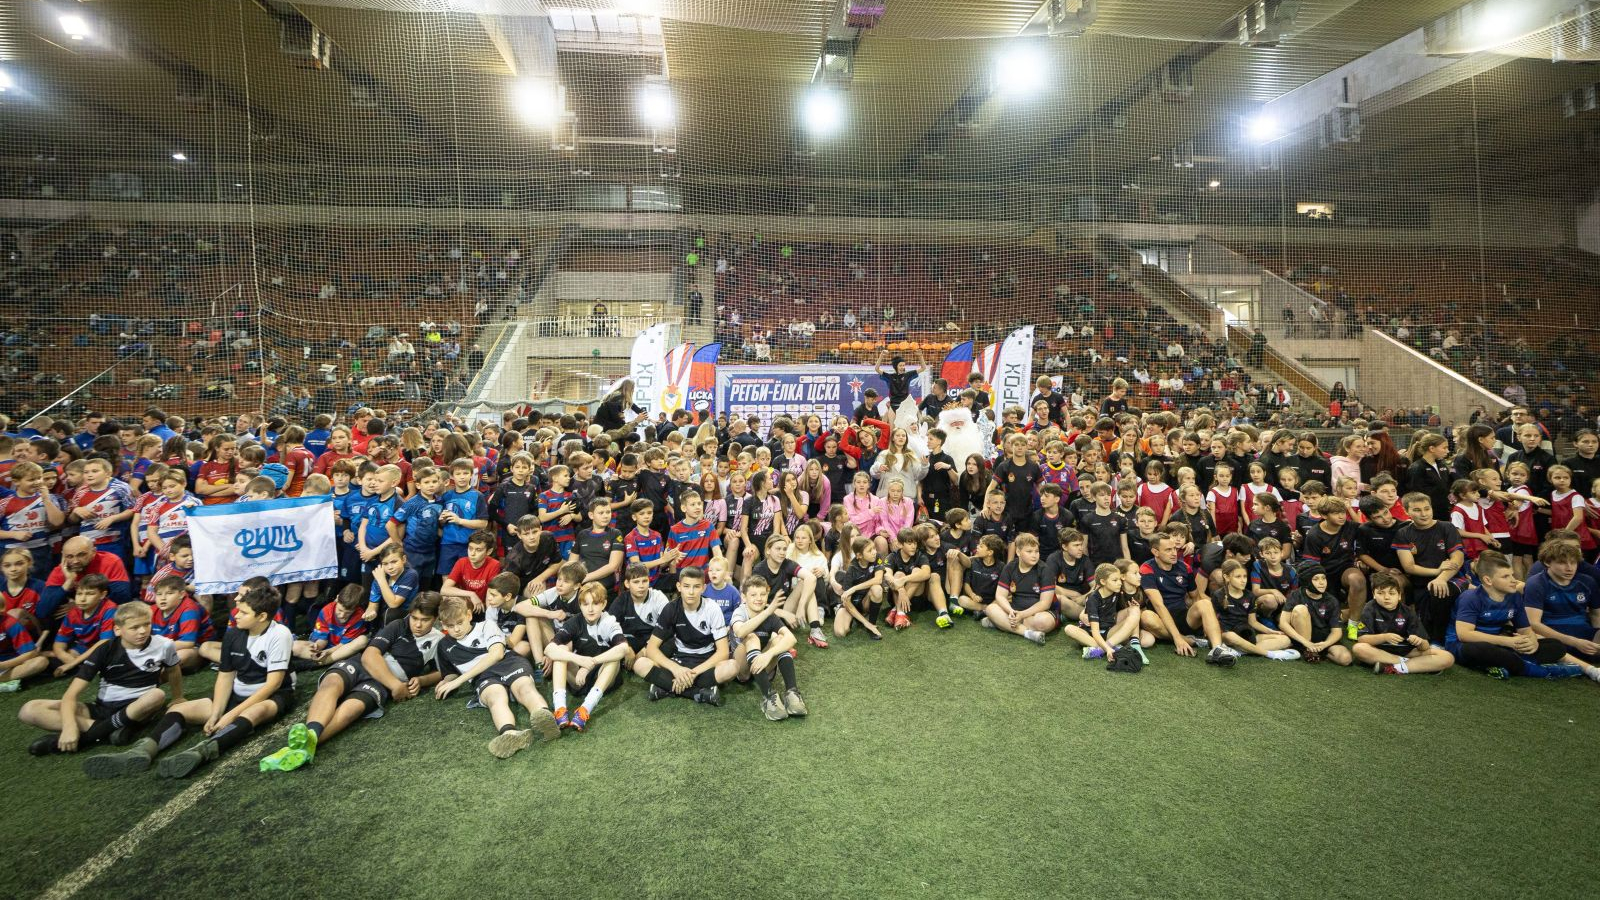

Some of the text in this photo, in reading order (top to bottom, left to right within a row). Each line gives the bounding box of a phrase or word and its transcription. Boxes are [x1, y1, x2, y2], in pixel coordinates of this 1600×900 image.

[688, 391, 714, 401] ЦСКА
[730, 381, 840, 403] РЕГБИ-ЁЛКА ЦСКА
[234, 524, 304, 559] ФИЛИ
